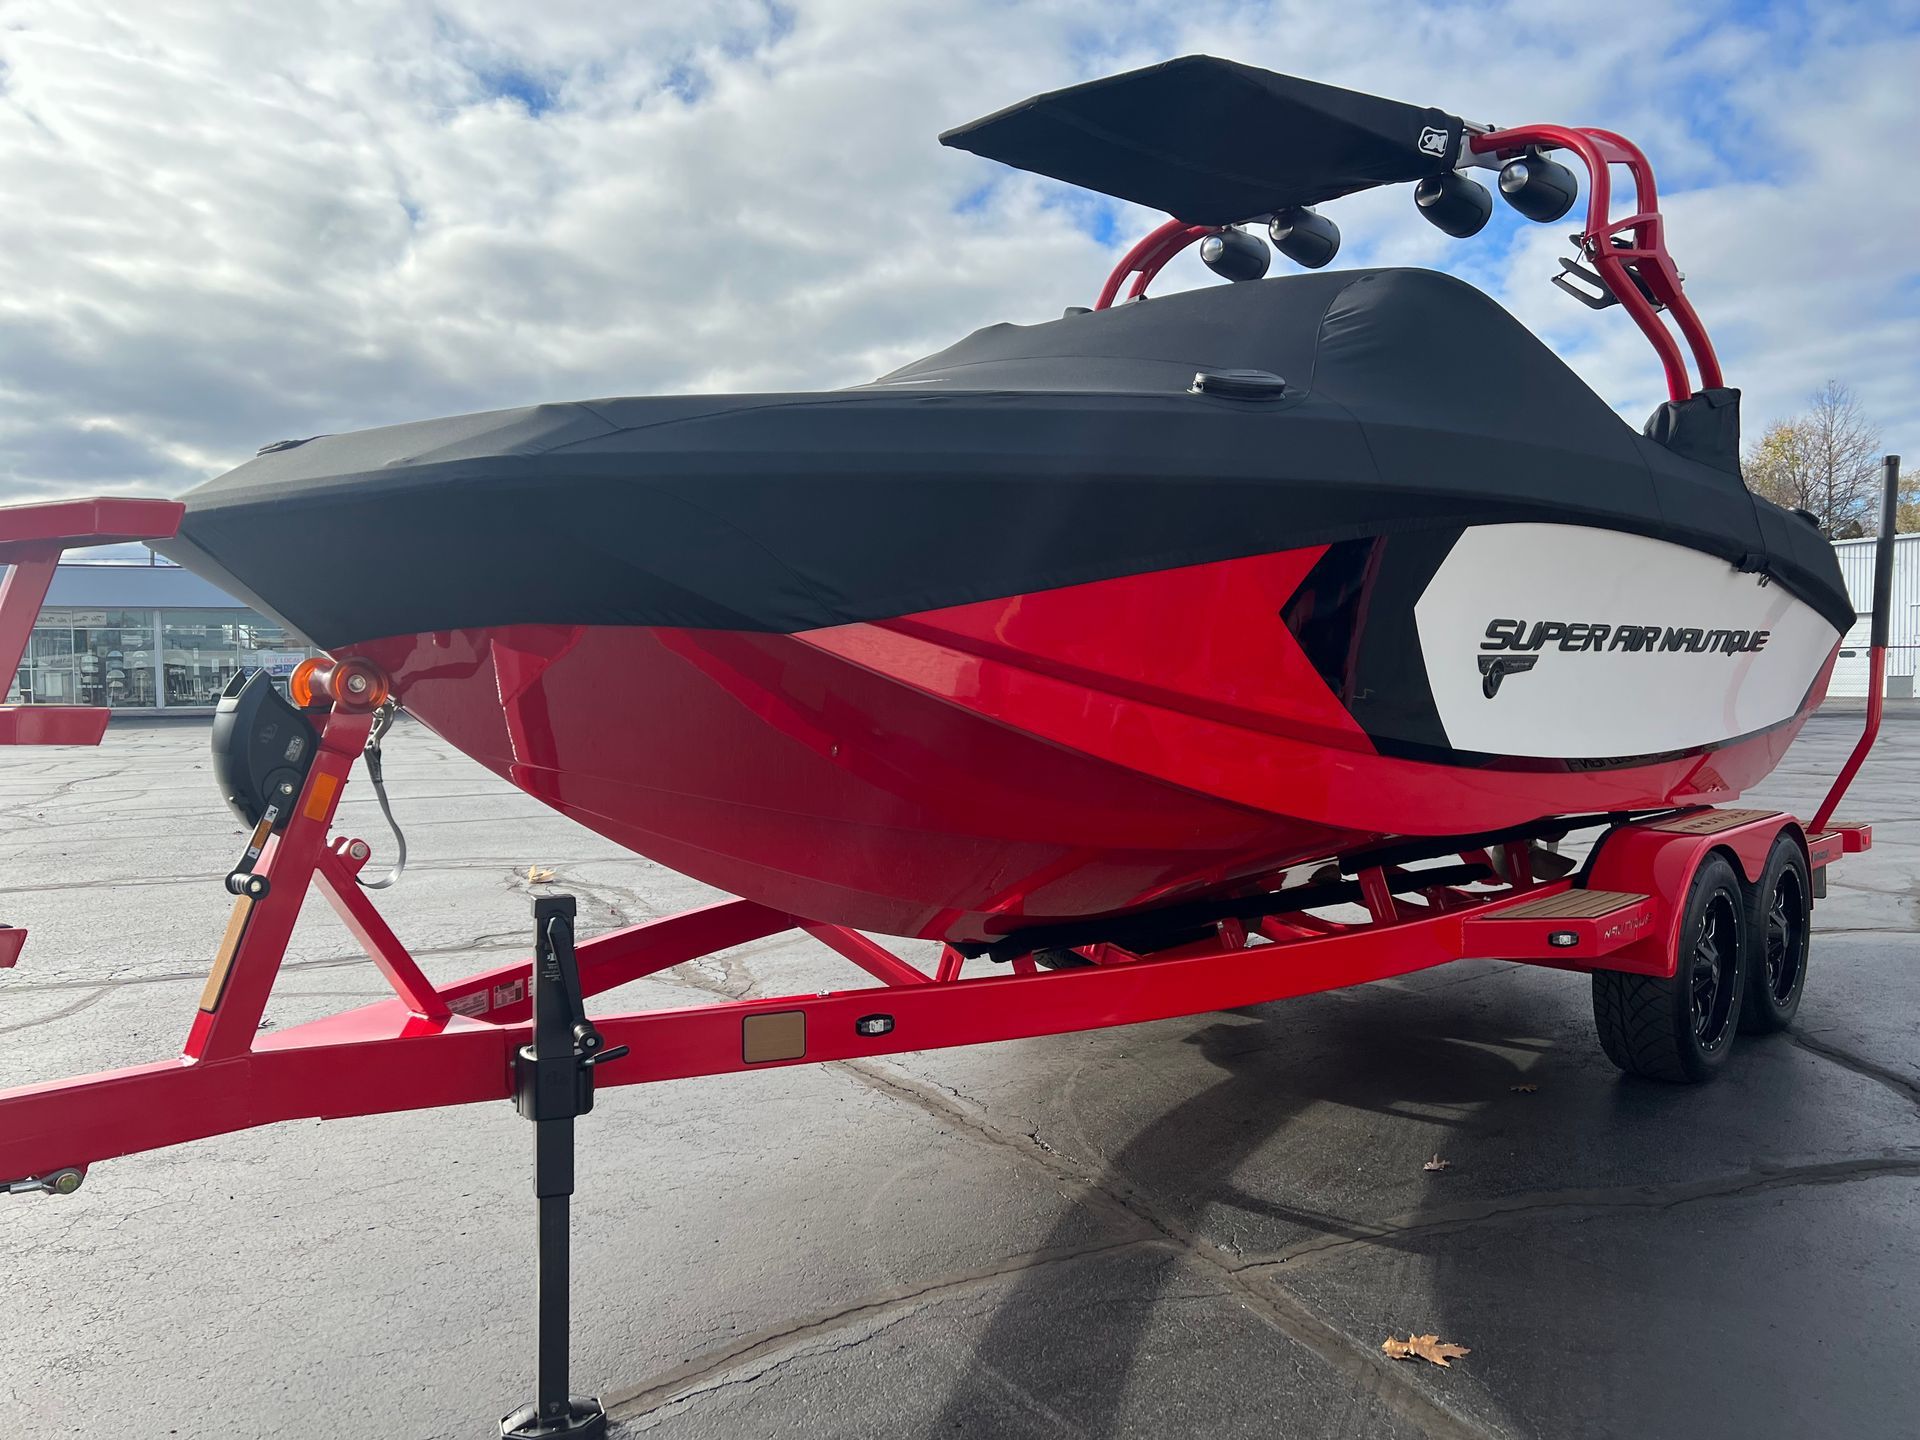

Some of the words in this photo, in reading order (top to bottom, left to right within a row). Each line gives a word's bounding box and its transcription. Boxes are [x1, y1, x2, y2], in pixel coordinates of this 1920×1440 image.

[1480, 618, 1611, 651] SUPER
[1608, 625, 1662, 652] AIR
[1658, 626, 1770, 657] NAUTIQUE
